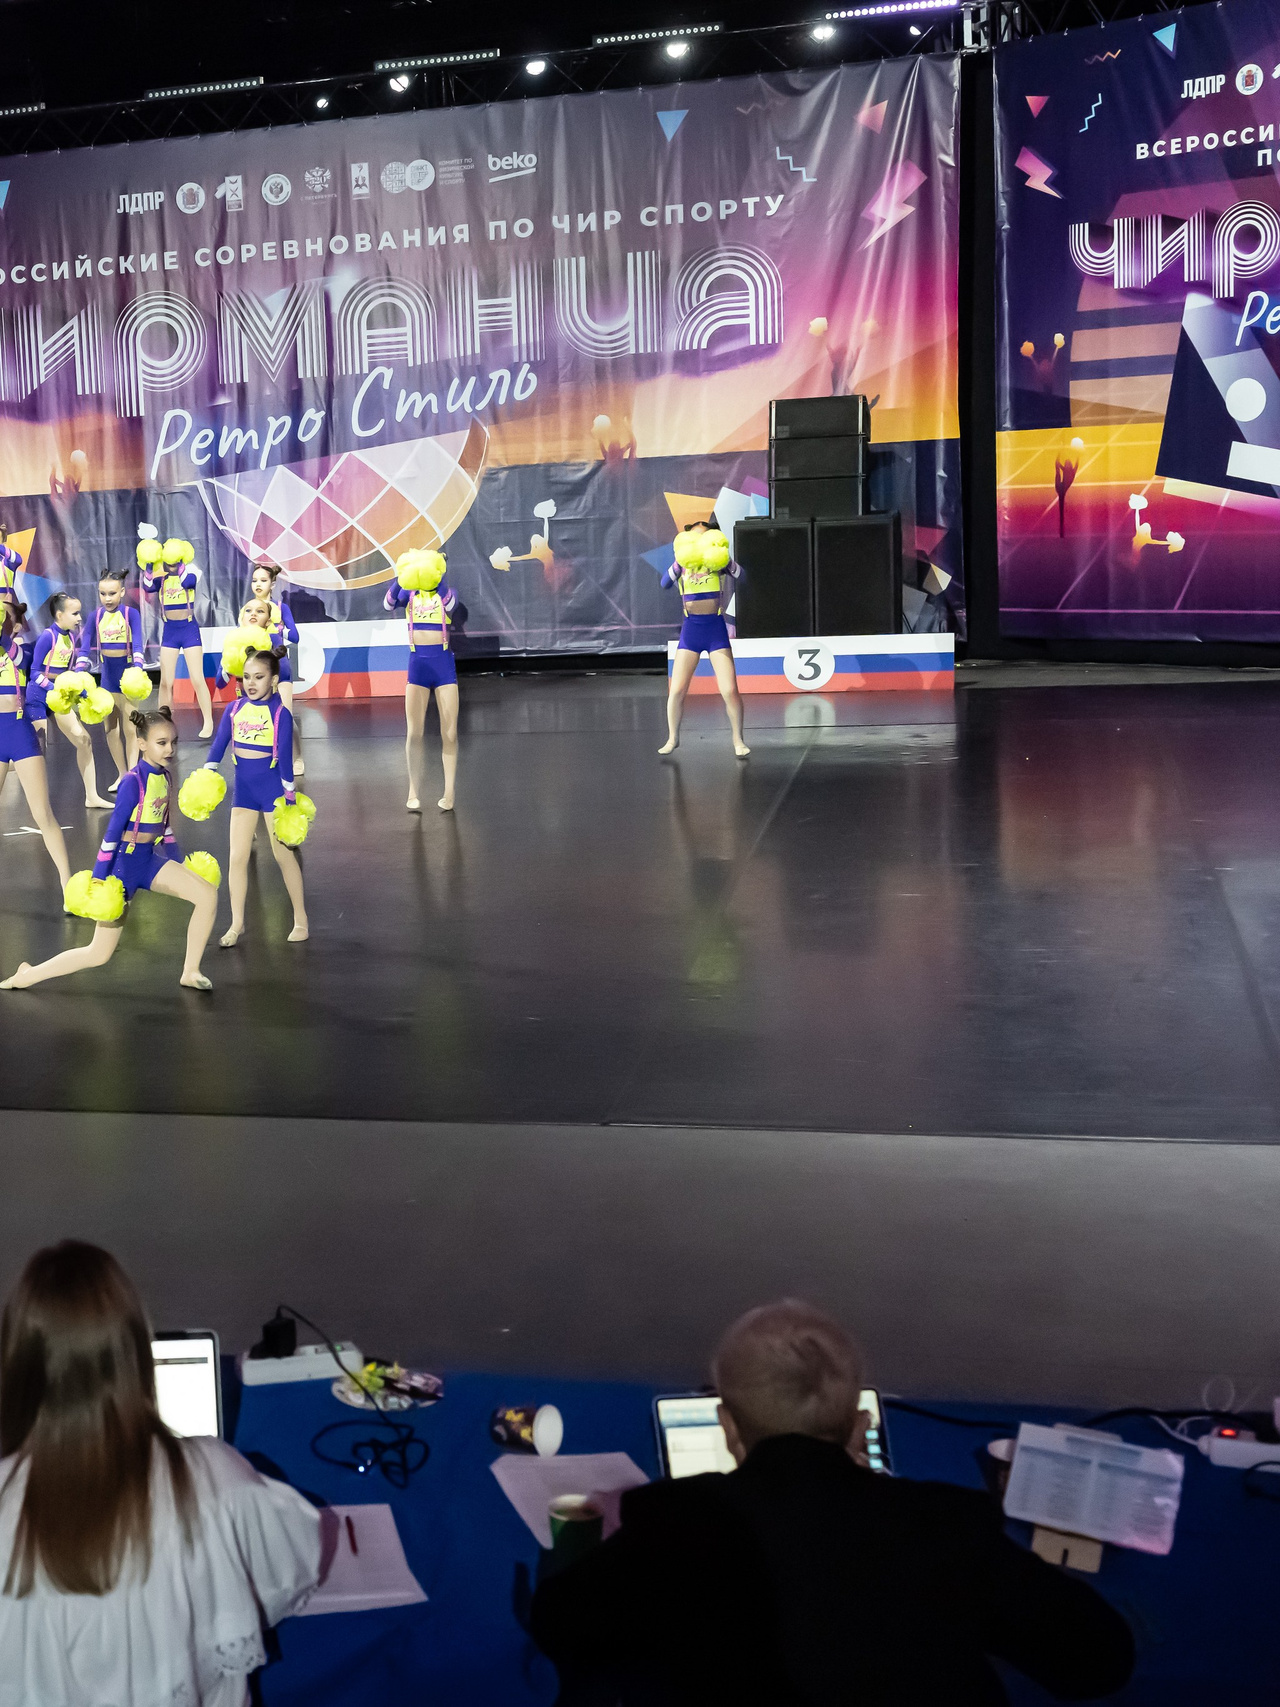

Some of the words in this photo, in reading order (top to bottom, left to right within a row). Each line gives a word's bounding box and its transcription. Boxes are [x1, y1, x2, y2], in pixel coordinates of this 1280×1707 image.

[1181, 74, 1226, 99] ЛДПР
[1136, 123, 1280, 160] ВСЕРОССИ
[487, 151, 538, 171] beko
[116, 190, 165, 215] ЛДПР
[194, 223, 470, 266] СОРЕВНОВАНИЯ
[488, 217, 535, 241] ПО
[553, 209, 622, 235] ЧИР
[639, 194, 786, 226] СПОРТУ
[150, 407, 326, 481] Ретро
[350, 363, 538, 438] Стиль
[797, 648, 821, 681] 3
